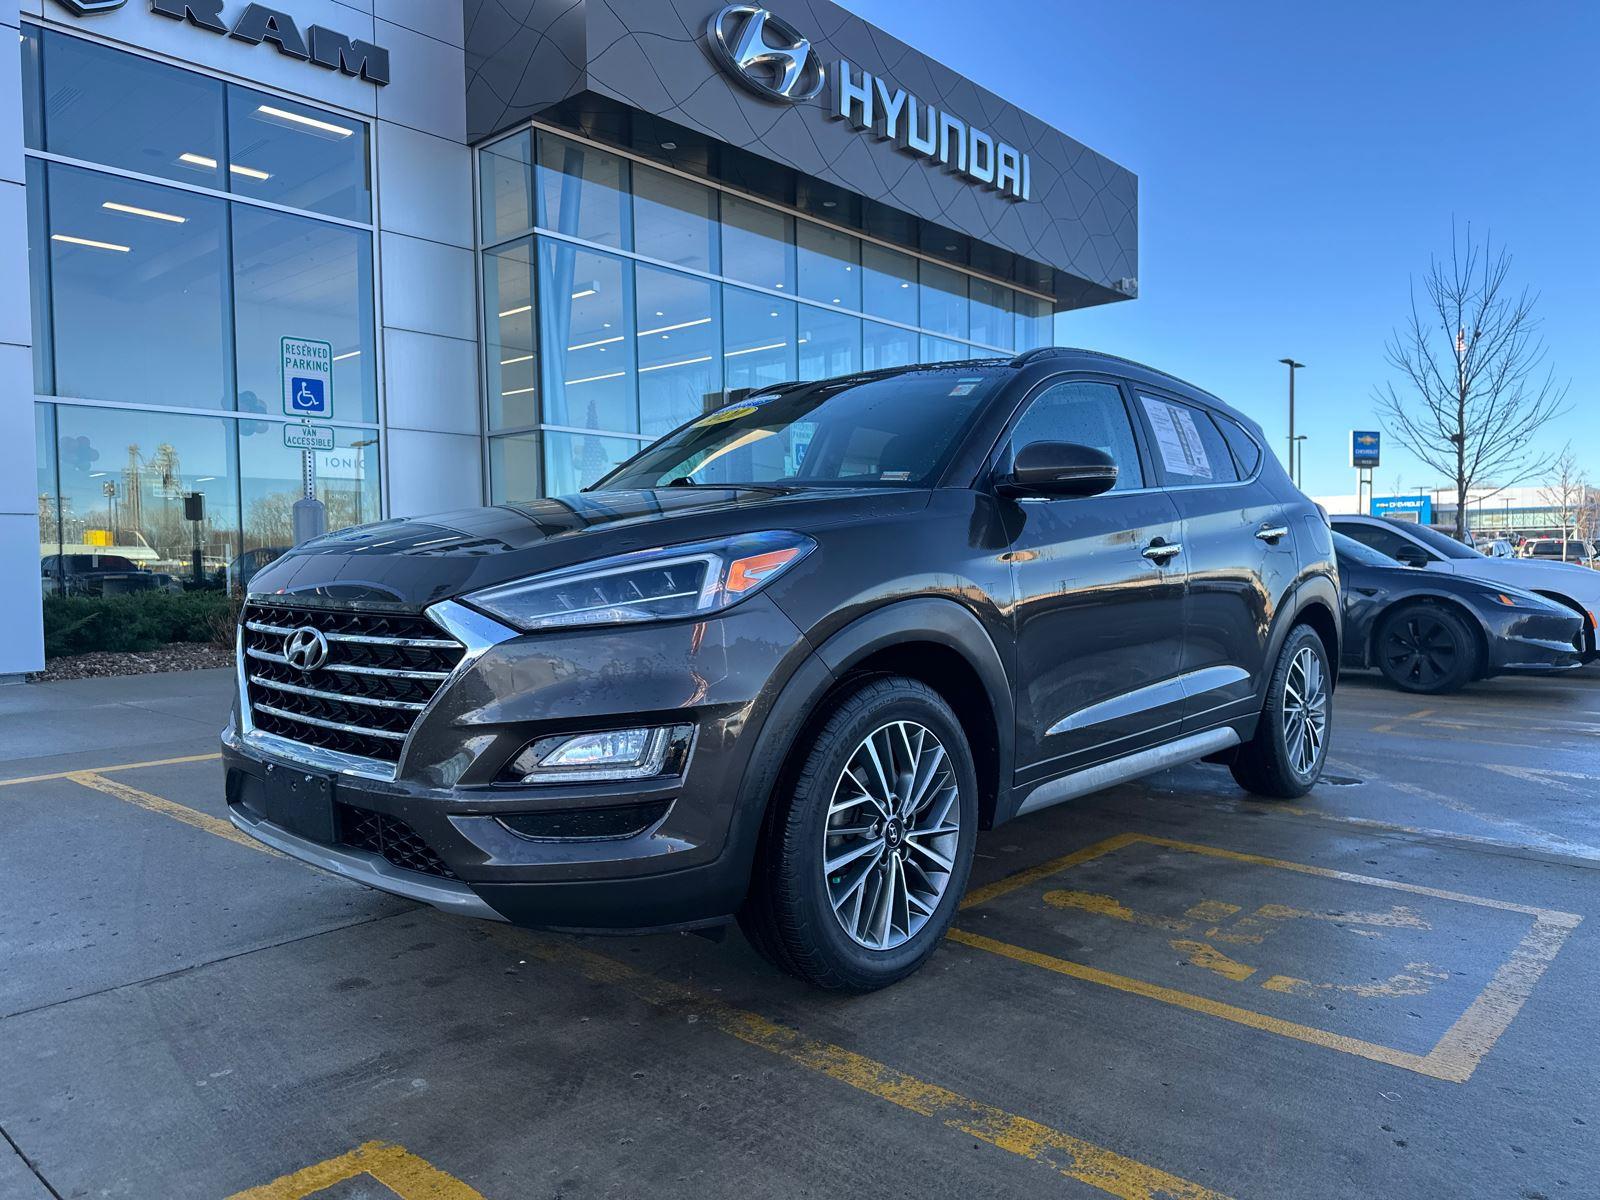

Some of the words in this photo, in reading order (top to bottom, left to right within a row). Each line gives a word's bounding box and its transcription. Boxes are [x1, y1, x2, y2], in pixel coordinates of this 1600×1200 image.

[834, 58, 1031, 201] HYUNDAI
[285, 343, 328, 359] RESERVED
[285, 358, 329, 372] PARKING
[302, 428, 317, 436] VAN
[286, 437, 332, 447] ACCESSIBLE
